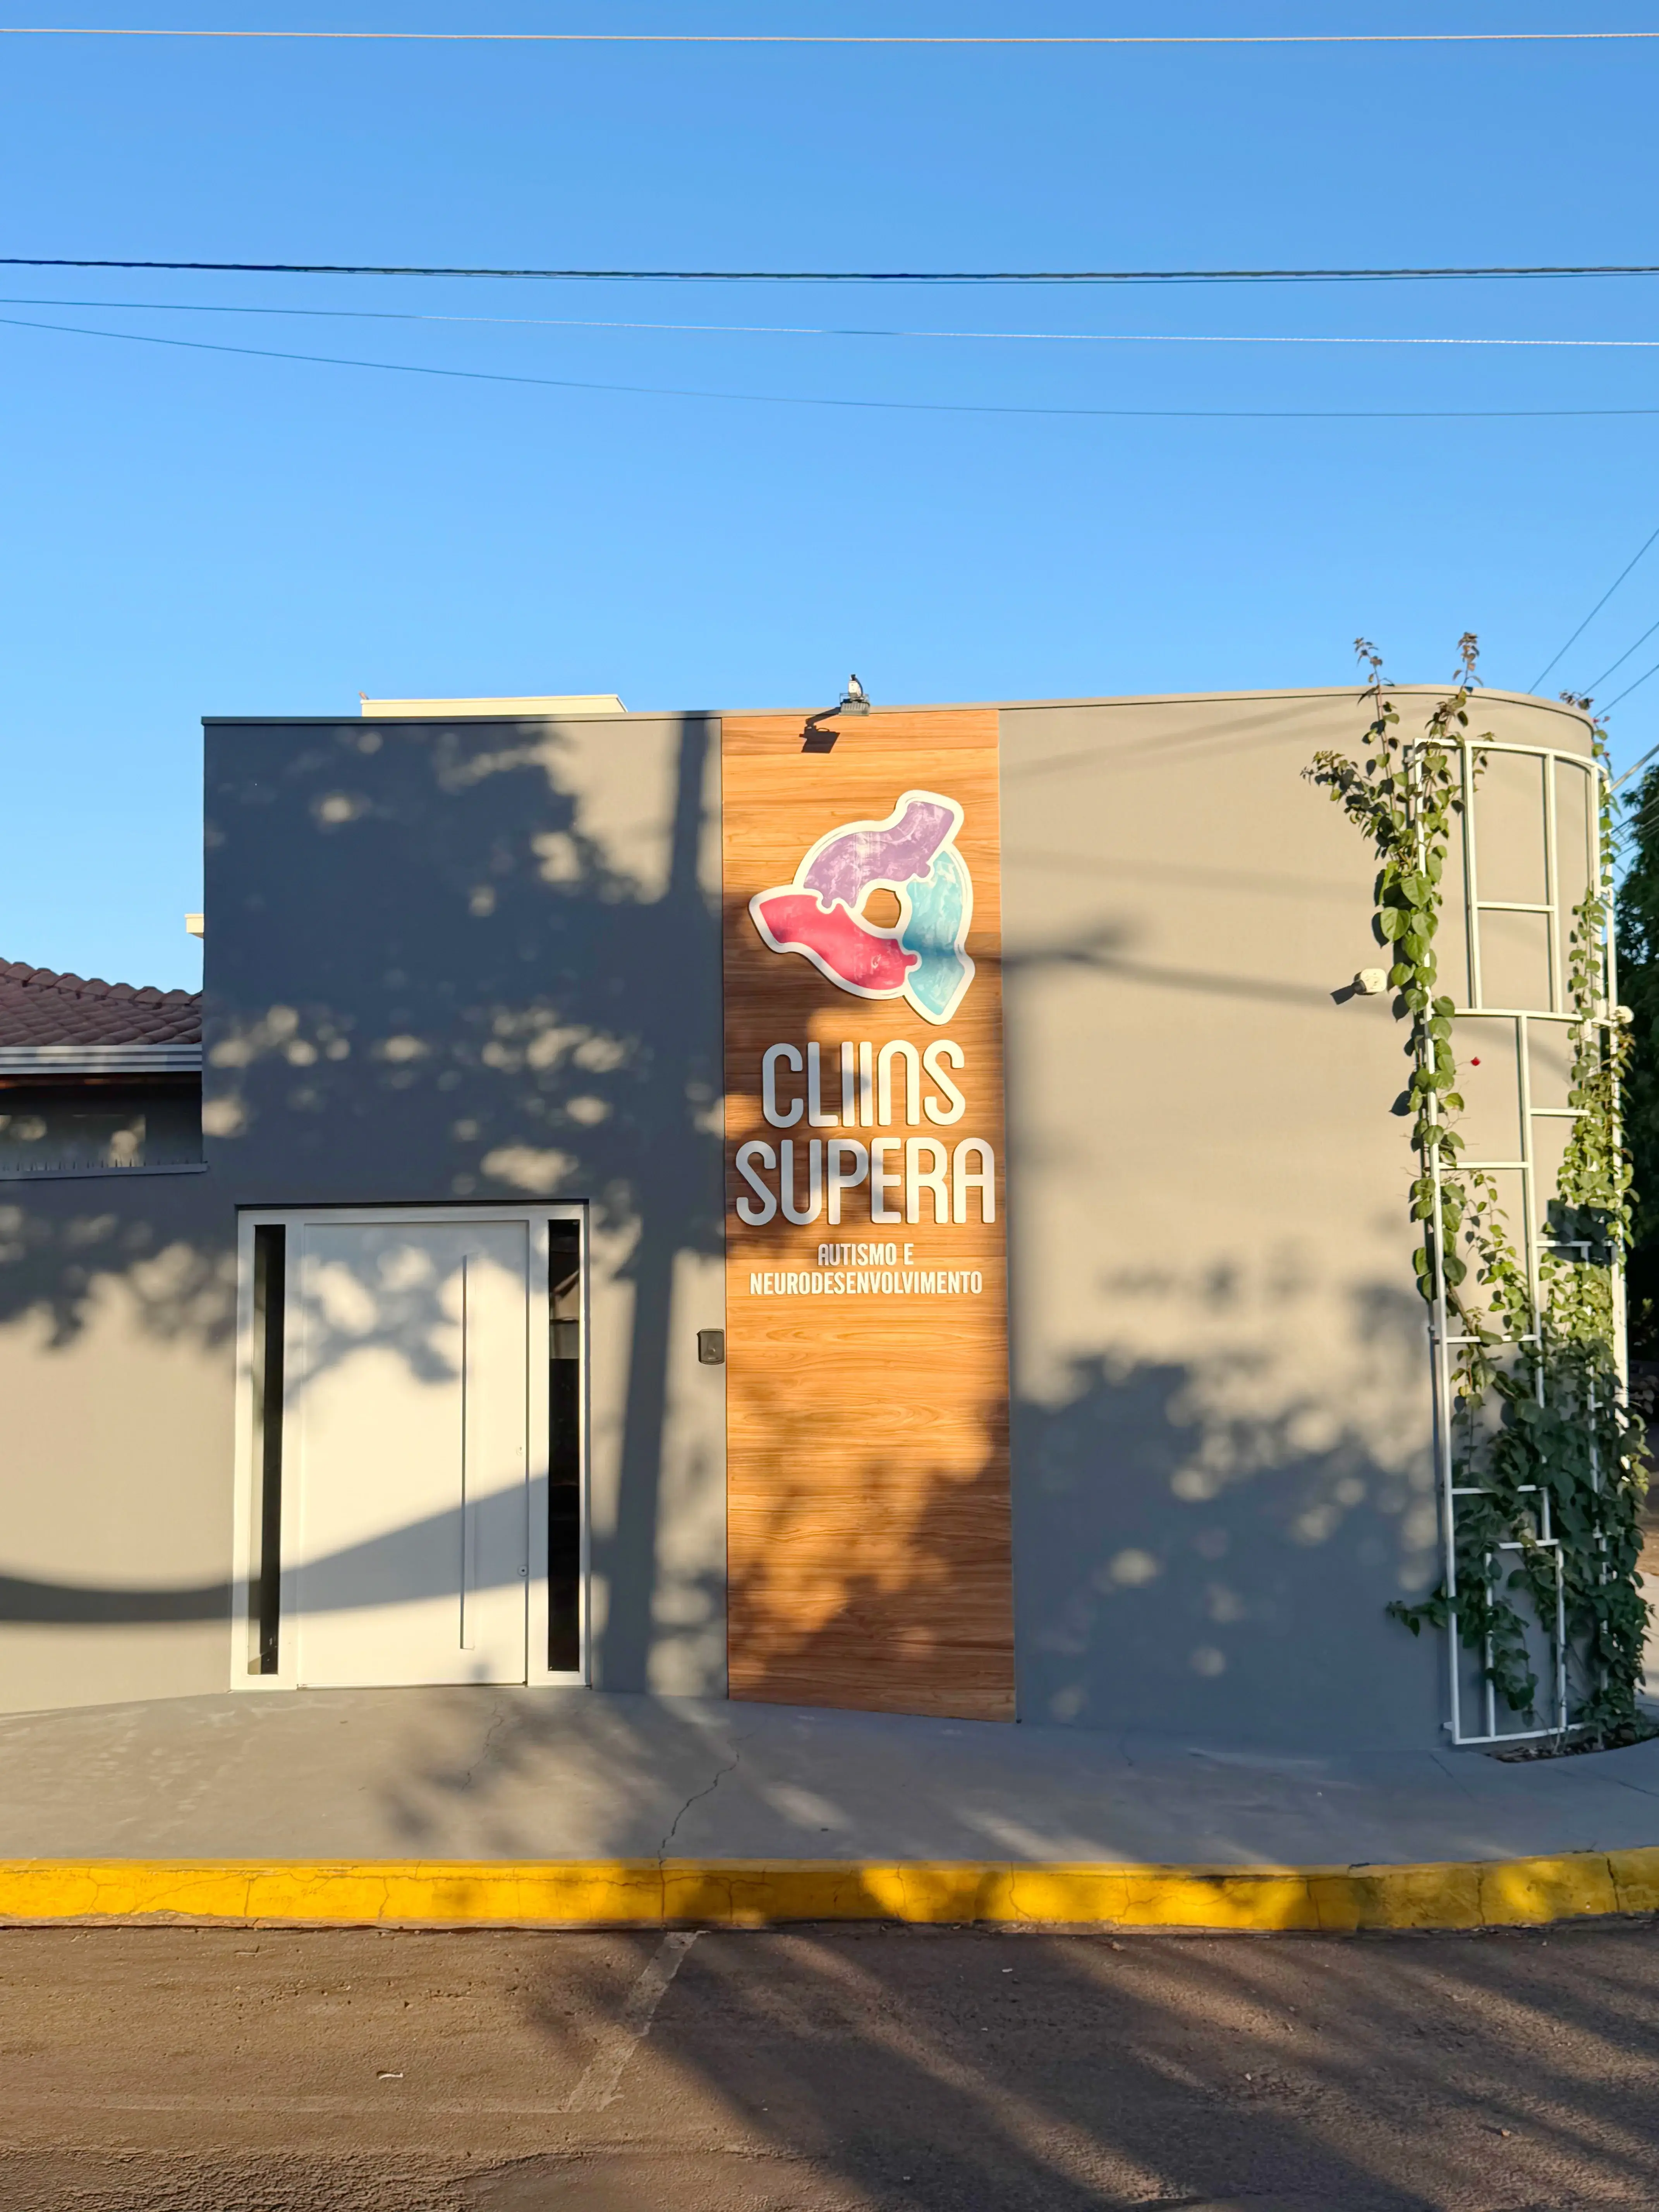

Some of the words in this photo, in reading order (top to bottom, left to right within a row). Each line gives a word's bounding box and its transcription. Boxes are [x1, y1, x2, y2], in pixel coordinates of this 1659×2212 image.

[736, 1137, 995, 1226] SUPERA
[818, 1243, 897, 1266] AUTISMO
[904, 1243, 914, 1265] E
[750, 1271, 982, 1295] NEURODESENVOLVIMENTO
